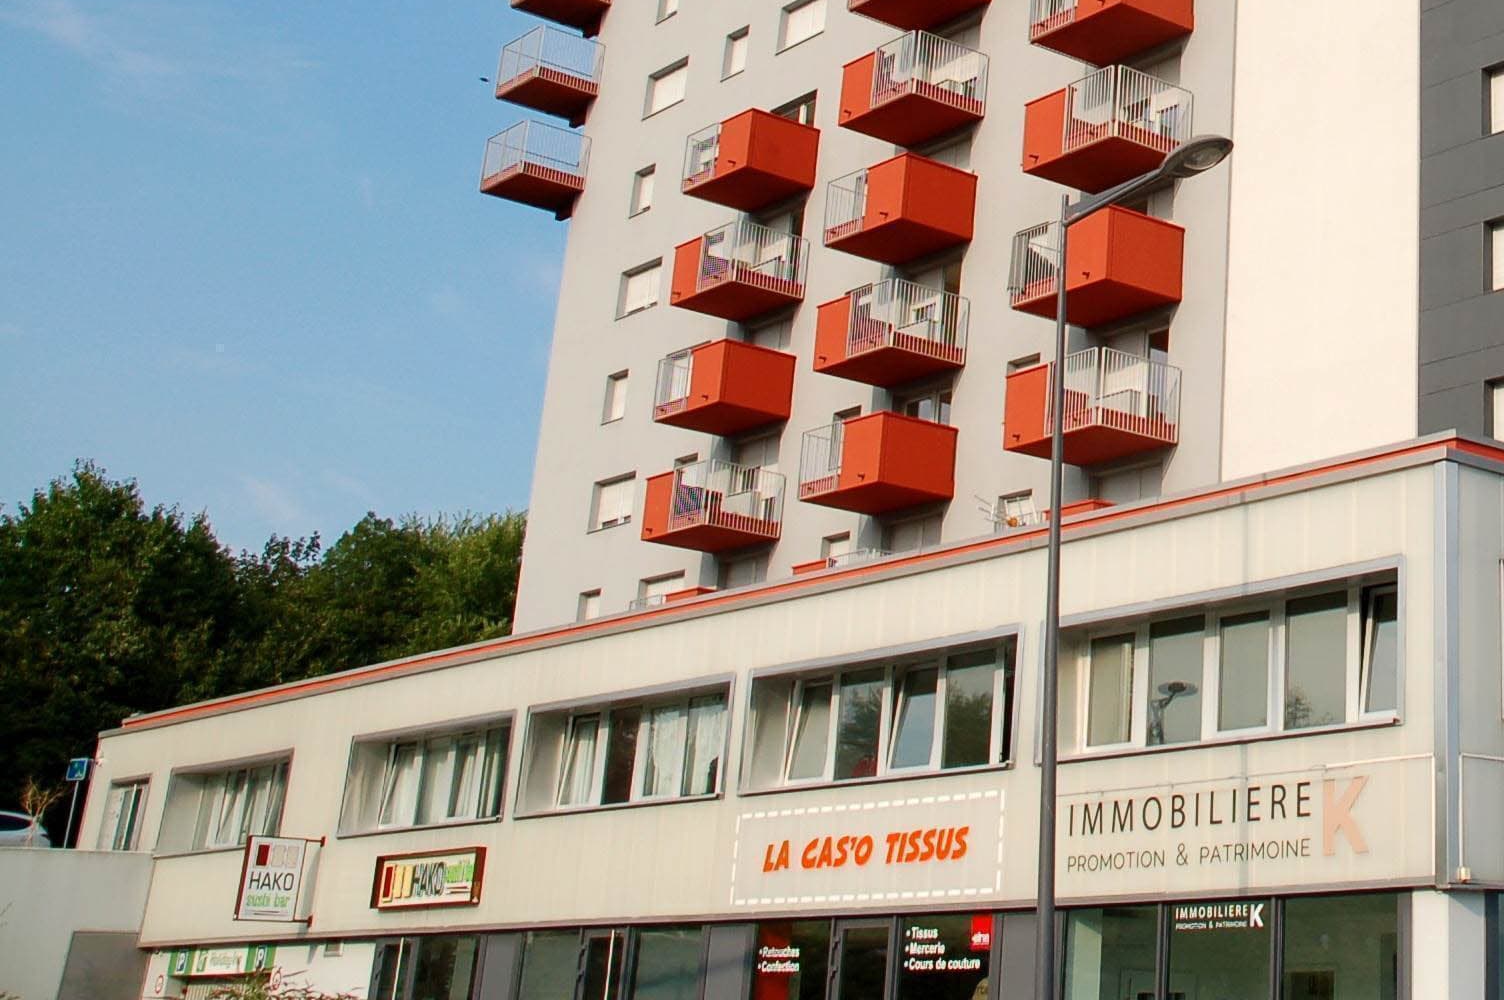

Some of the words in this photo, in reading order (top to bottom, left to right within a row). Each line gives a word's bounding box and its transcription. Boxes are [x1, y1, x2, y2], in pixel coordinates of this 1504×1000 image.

[1069, 781, 1311, 837] IMMOBILIERE
[1323, 775, 1370, 857] K
[762, 840, 790, 872] LA
[886, 826, 970, 864] TISSUS
[1067, 849, 1166, 872] PROMOTION
[1176, 842, 1188, 866] &
[1199, 838, 1312, 864] PATRIMOINE
[249, 871, 295, 891] HAKO
[412, 861, 446, 897] HAKO
[1175, 904, 1248, 920] IMMOBILIERE
[1249, 903, 1264, 928] K
[911, 926, 939, 939] Tissus
[909, 941, 946, 955] Mercerie
[908, 957, 934, 970] Cours
[935, 957, 947, 970] de
[948, 957, 981, 970] couture
